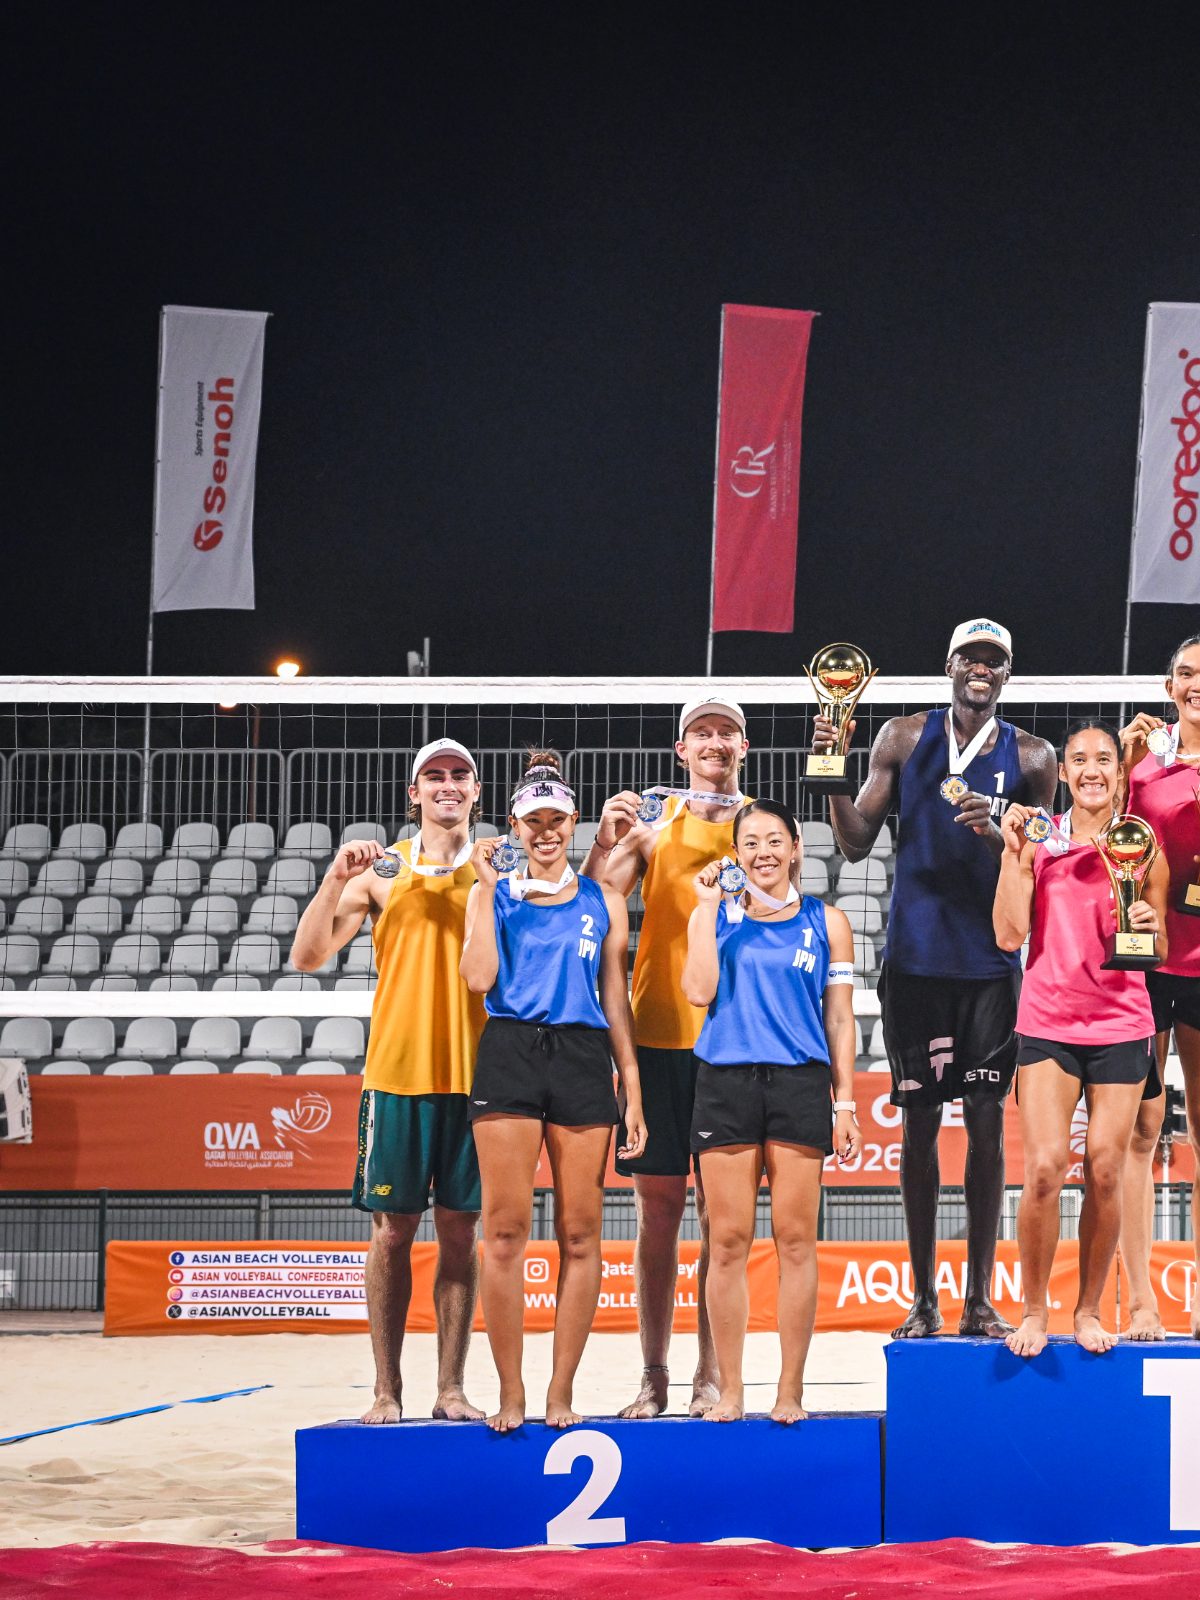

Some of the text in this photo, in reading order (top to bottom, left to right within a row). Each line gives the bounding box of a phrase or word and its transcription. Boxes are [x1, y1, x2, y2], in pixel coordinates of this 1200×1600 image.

[203, 377, 235, 514] Senoh
[994, 771, 1005, 794] 1
[581, 914, 594, 937] 2
[802, 927, 813, 948] 1
[792, 948, 817, 974] JPN
[204, 1121, 261, 1150] QVA
[192, 1254, 365, 1264] ASIAN BEACH VOLLEYBALL
[191, 1271, 366, 1282] ASIAN VOLLEYBALL CONFEDERATION
[191, 1288, 365, 1299] @ASIANBEACHVOLLEYBALL
[188, 1306, 331, 1317] @ASIANVOLLEYBALL
[543, 1429, 626, 1545] 2
